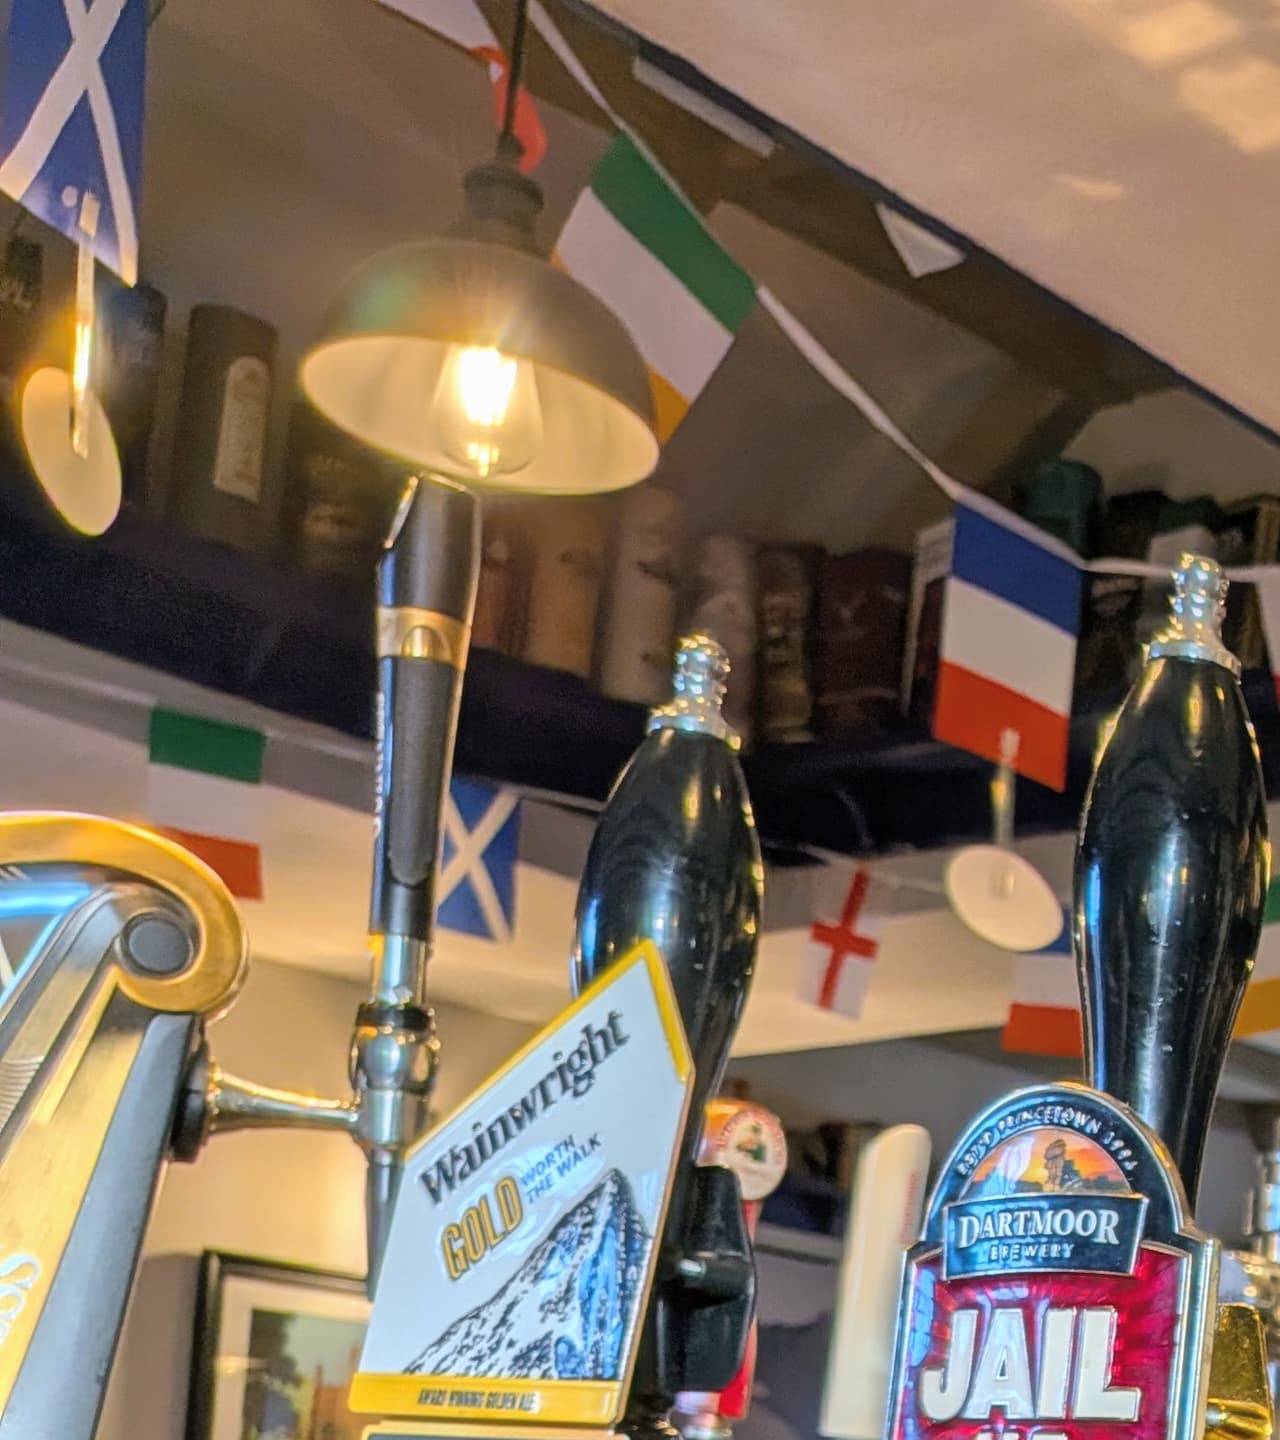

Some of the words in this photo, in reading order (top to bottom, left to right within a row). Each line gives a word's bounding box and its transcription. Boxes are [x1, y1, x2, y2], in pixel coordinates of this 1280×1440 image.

[420, 1010, 630, 1205] Wainwright
[519, 1135, 576, 1187] WORTH
[526, 1178, 554, 1205] THE
[557, 1132, 602, 1182] WALK
[441, 1175, 523, 1281] GOLD
[958, 1208, 1120, 1249] DARTMOOR
[990, 1242, 1075, 1261] BREWERY
[920, 1306, 1141, 1422] JAIL
